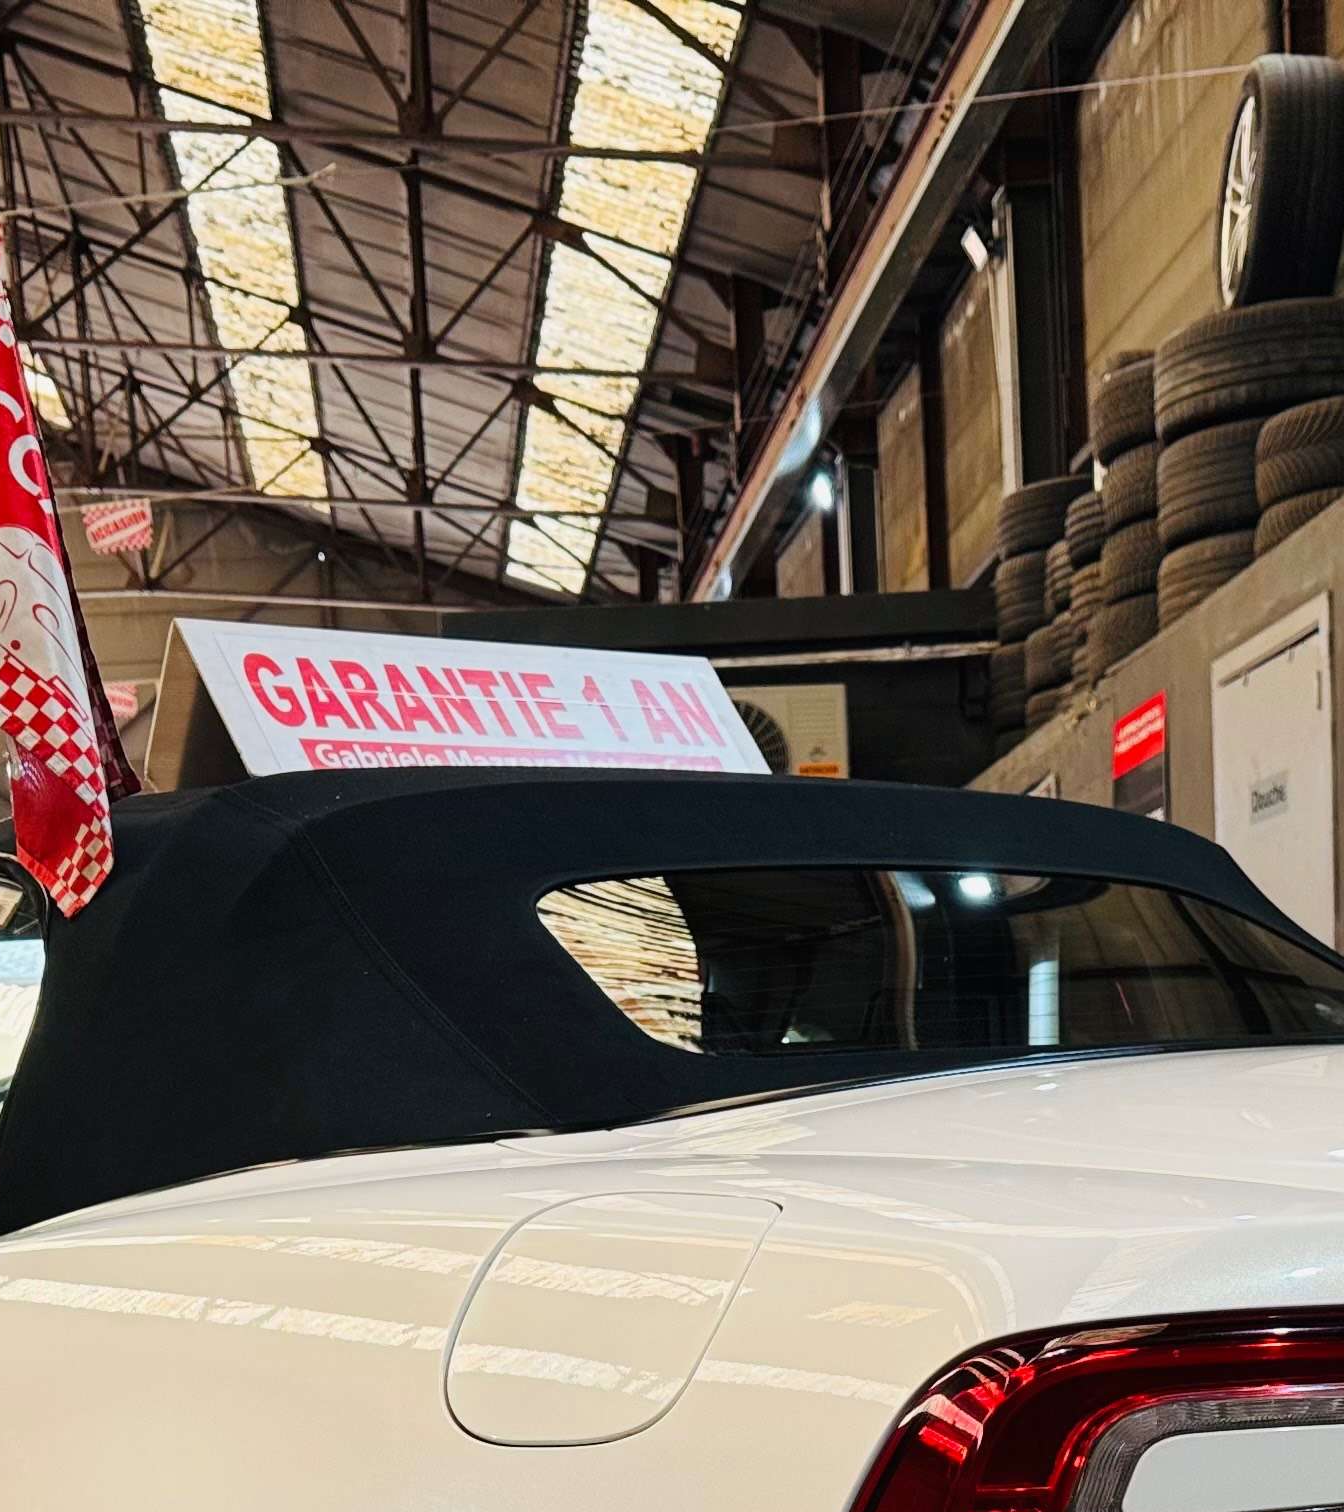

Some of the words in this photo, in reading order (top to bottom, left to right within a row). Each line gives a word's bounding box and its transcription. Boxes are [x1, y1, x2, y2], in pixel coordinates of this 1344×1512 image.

[242, 652, 582, 738] GARANTIE
[582, 675, 627, 742] 1
[630, 679, 726, 747] AN
